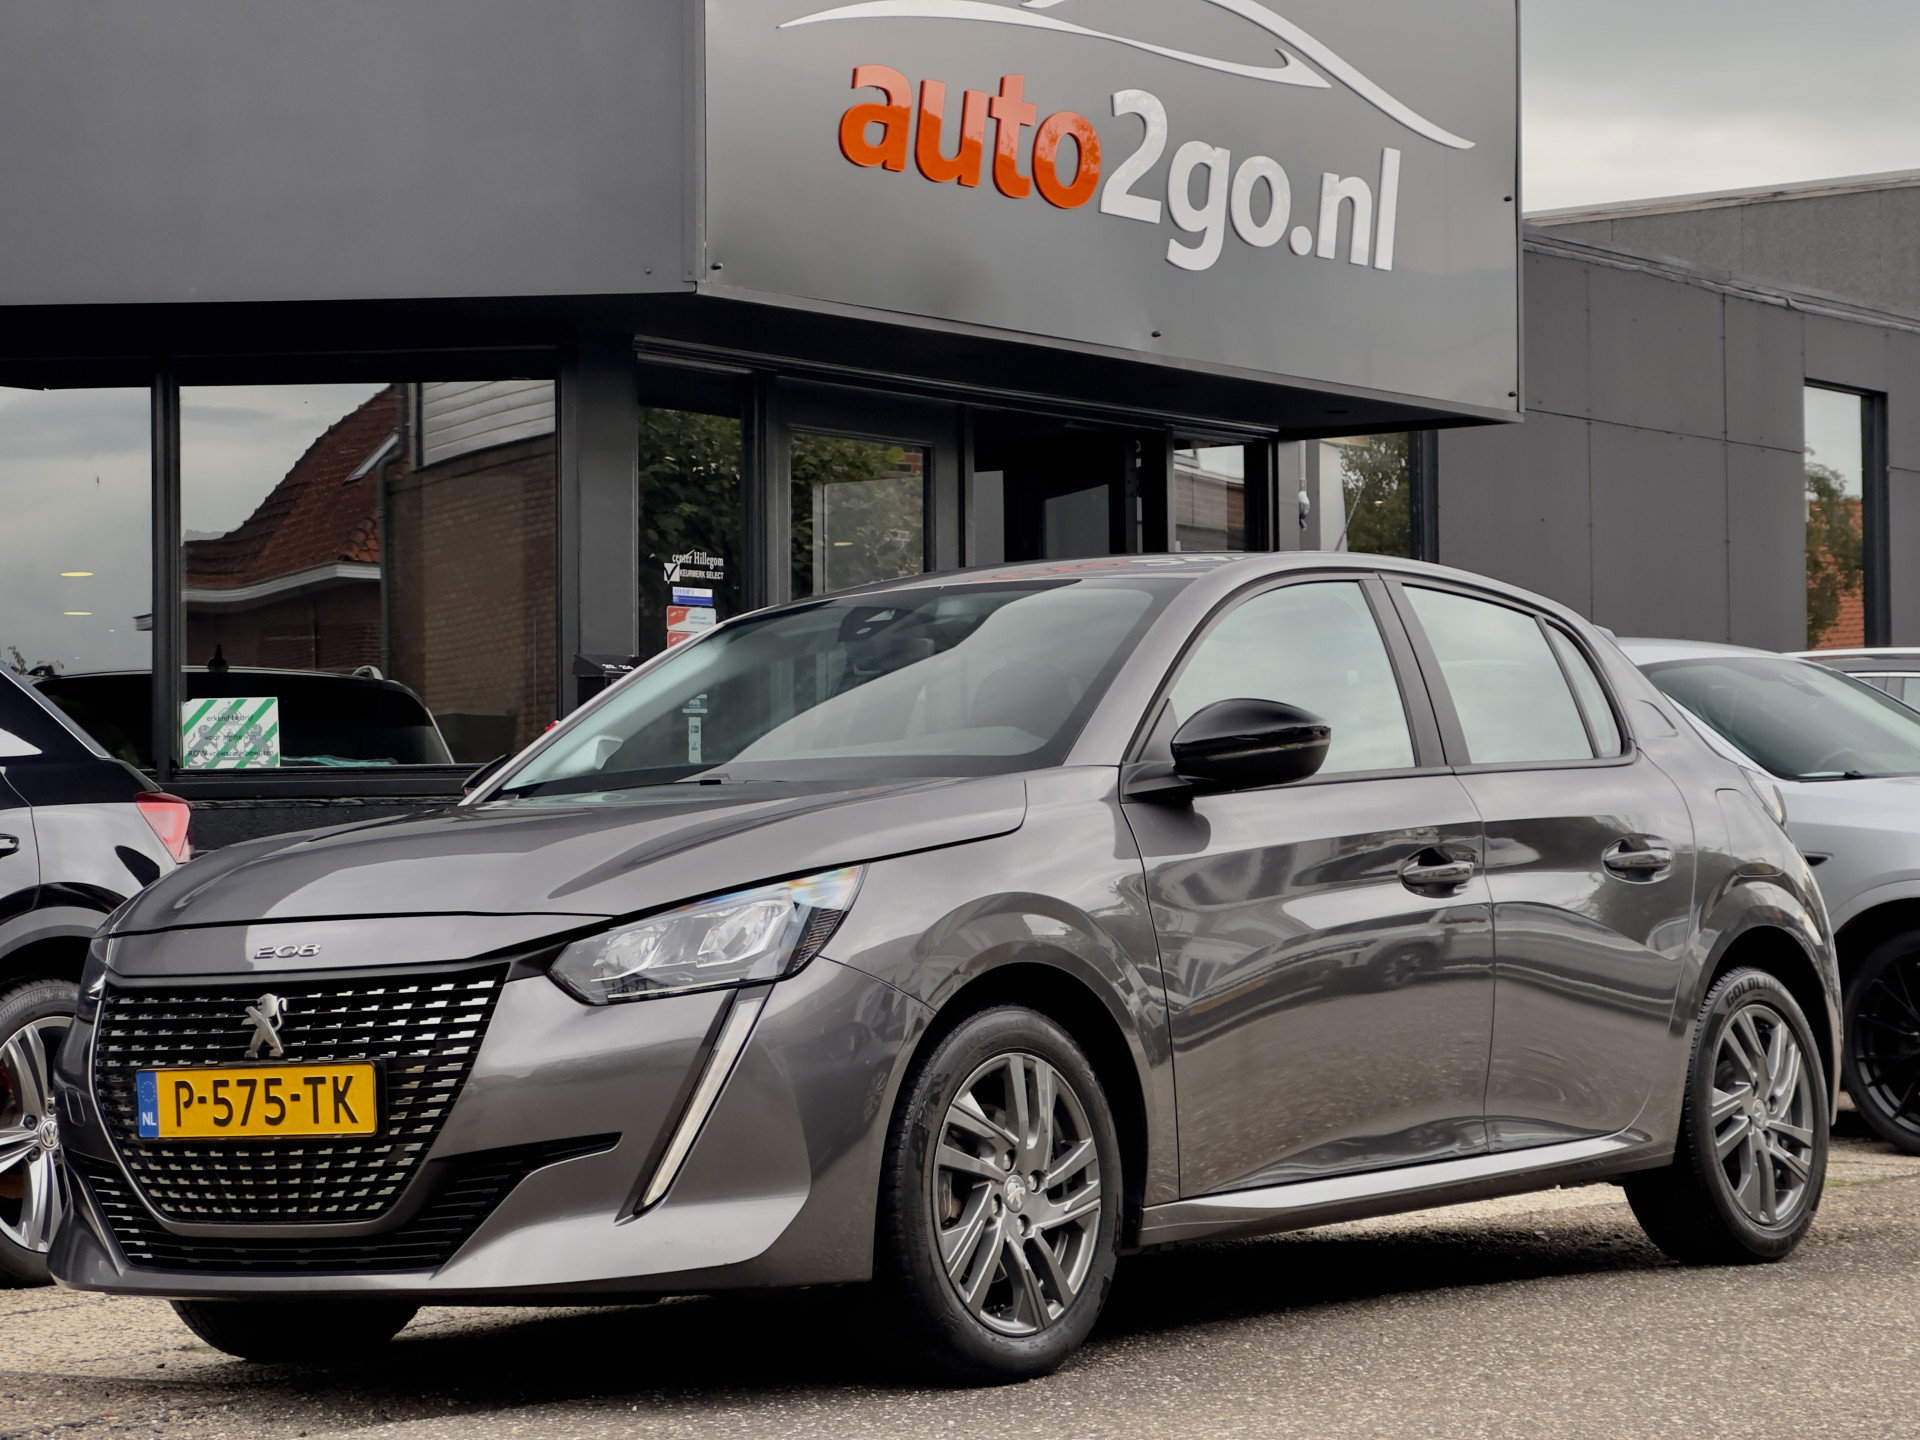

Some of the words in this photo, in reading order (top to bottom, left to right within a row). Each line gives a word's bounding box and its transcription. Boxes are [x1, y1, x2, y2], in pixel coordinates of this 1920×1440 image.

[839, 63, 1402, 271] auto2go.nl
[694, 551, 724, 570] Hillegom
[706, 570, 724, 580] SELECT
[254, 944, 321, 959] 208
[174, 1075, 359, 1127] P-575-TK
[142, 1112, 157, 1126] NL
